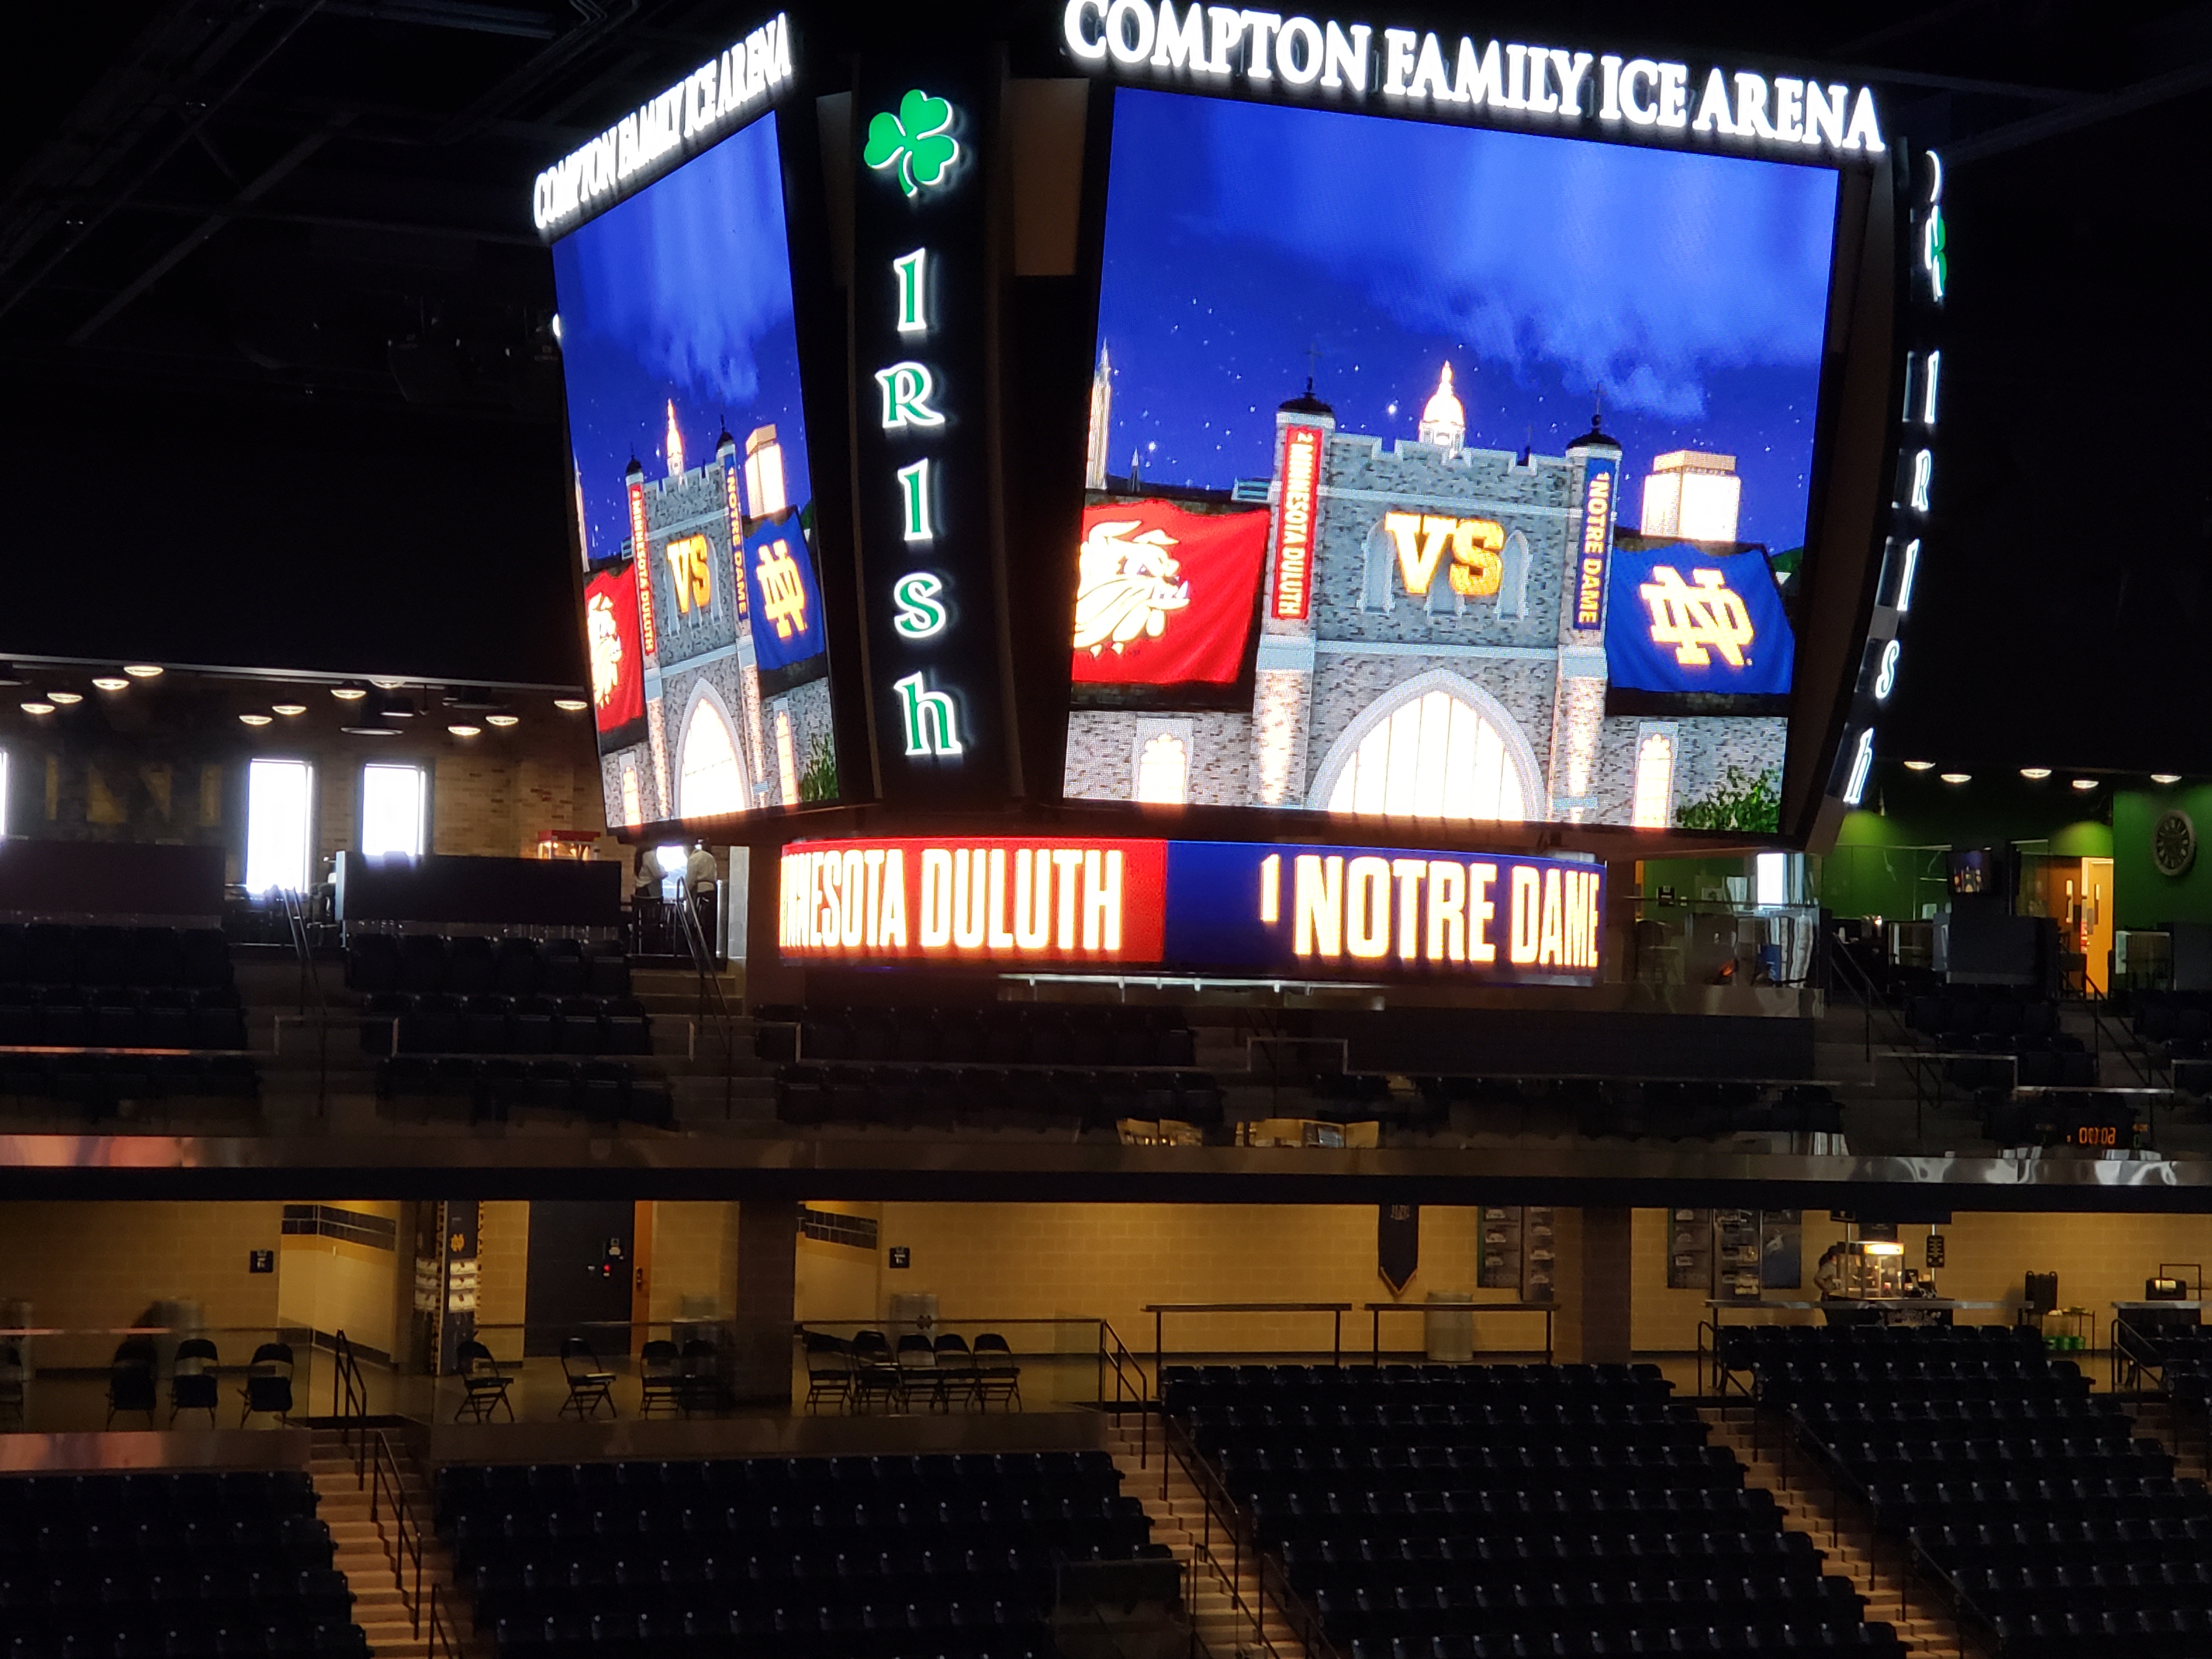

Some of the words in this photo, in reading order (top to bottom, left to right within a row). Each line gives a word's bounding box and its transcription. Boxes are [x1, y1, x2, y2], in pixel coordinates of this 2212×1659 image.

[1064, 0, 1372, 91] COMPTON
[1383, 29, 1593, 115] FAMILY
[1599, 55, 1687, 128] ICE
[1692, 67, 1886, 151] ARENA
[534, 126, 617, 229] COMPTON
[683, 59, 717, 138] ICE
[715, 12, 792, 117] ARENA
[726, 476, 741, 548] NOTRE
[1284, 443, 1314, 545] MINNESOTA
[1584, 480, 1610, 554] NOTRE
[631, 499, 649, 589] MINNESOTA
[641, 590, 655, 652] DULUTH
[666, 534, 710, 614] VS
[733, 550, 748, 615] DAME
[1278, 546, 1306, 615] DULUTH
[1384, 511, 1505, 596] VS
[1578, 558, 1603, 624] DAME
[921, 848, 1122, 951] DULUTH
[1260, 854, 1280, 922] 1
[1293, 854, 1498, 963] NOTRE
[1510, 864, 1600, 968] DAME
